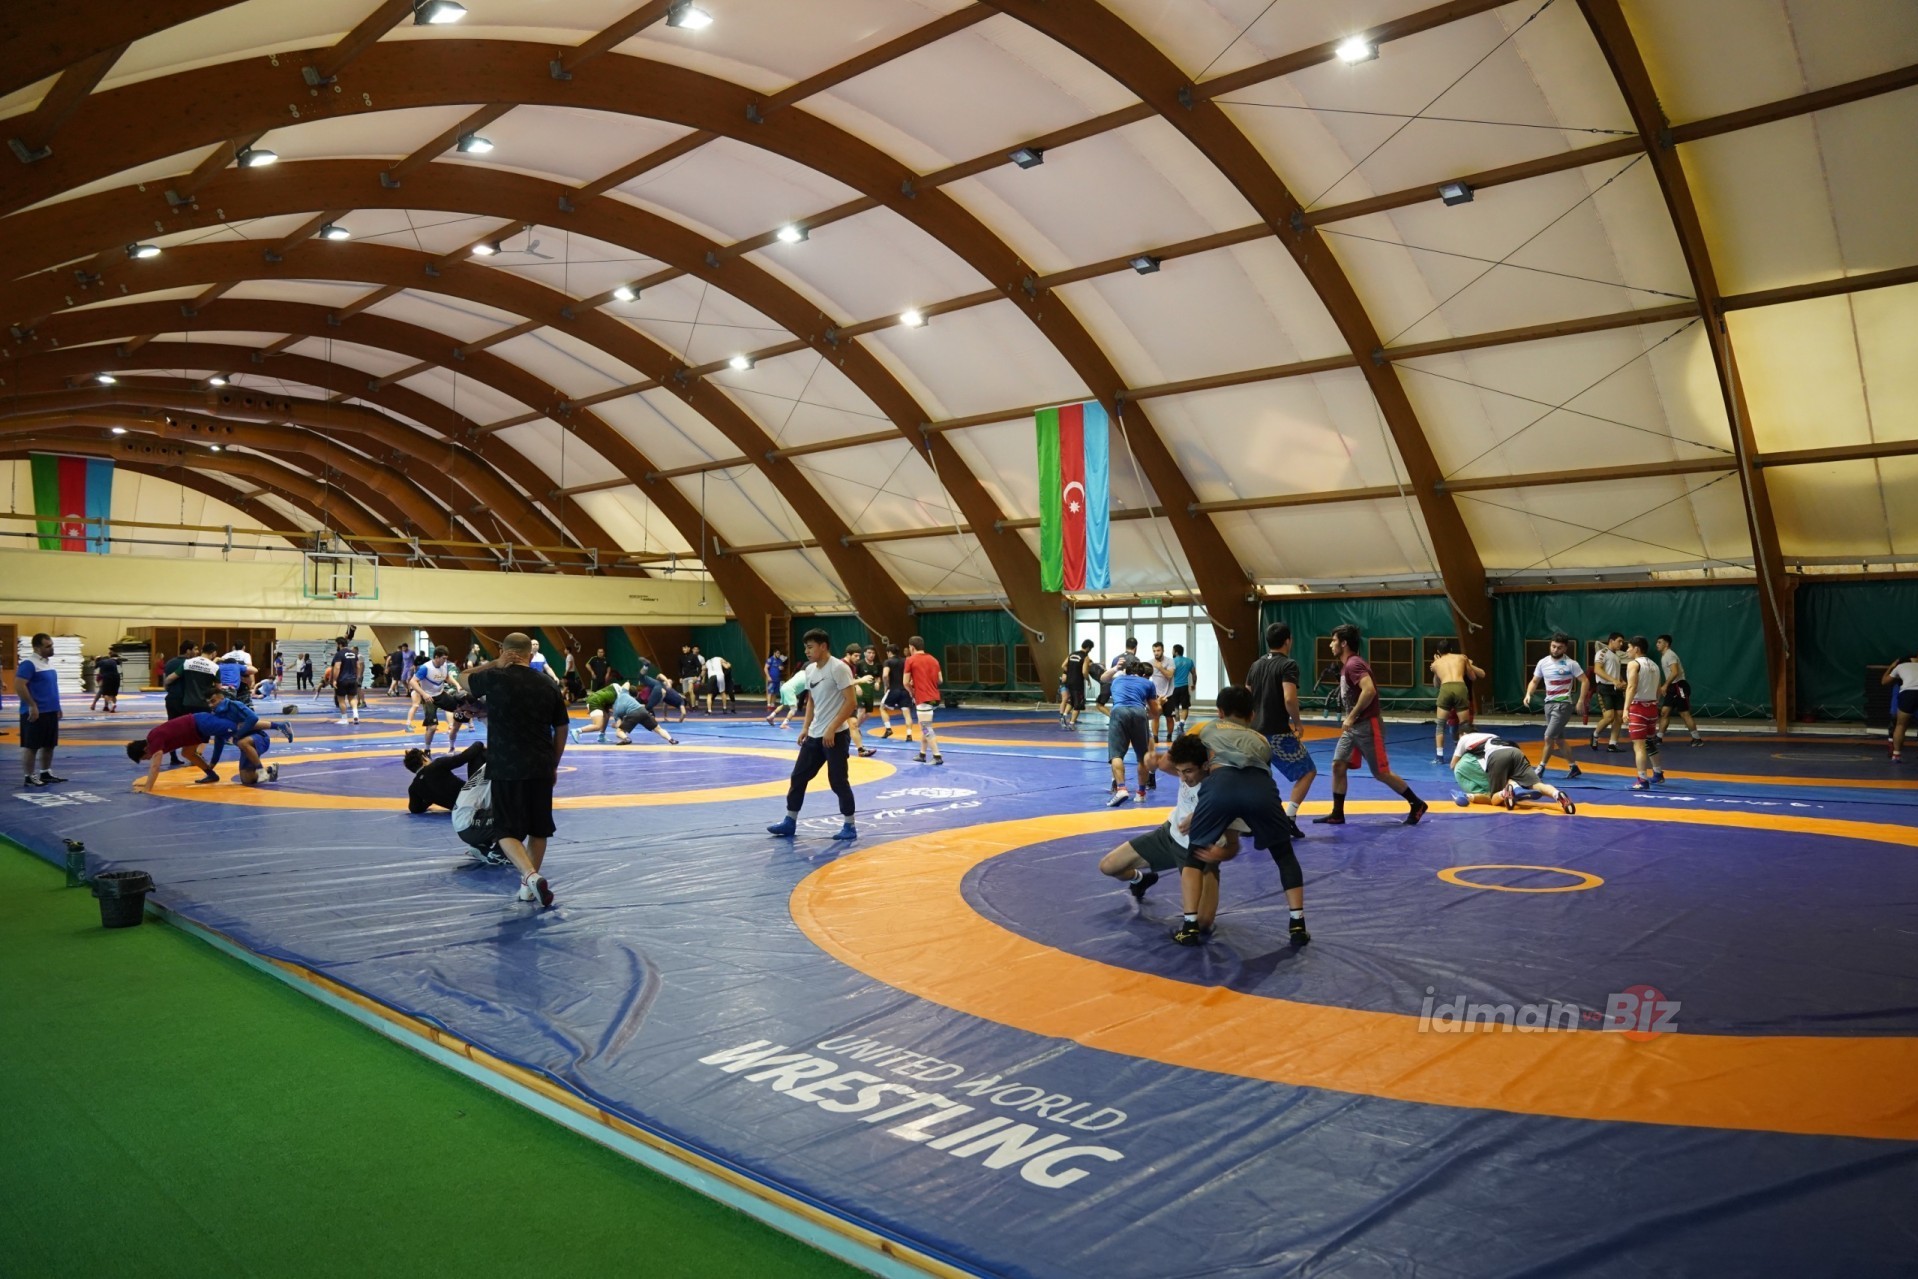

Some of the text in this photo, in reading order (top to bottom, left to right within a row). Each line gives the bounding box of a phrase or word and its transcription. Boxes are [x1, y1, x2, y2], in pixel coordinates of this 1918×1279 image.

[699, 1039, 1125, 1189] WRESTLING
[816, 1035, 1127, 1131] UNITED WORLD
